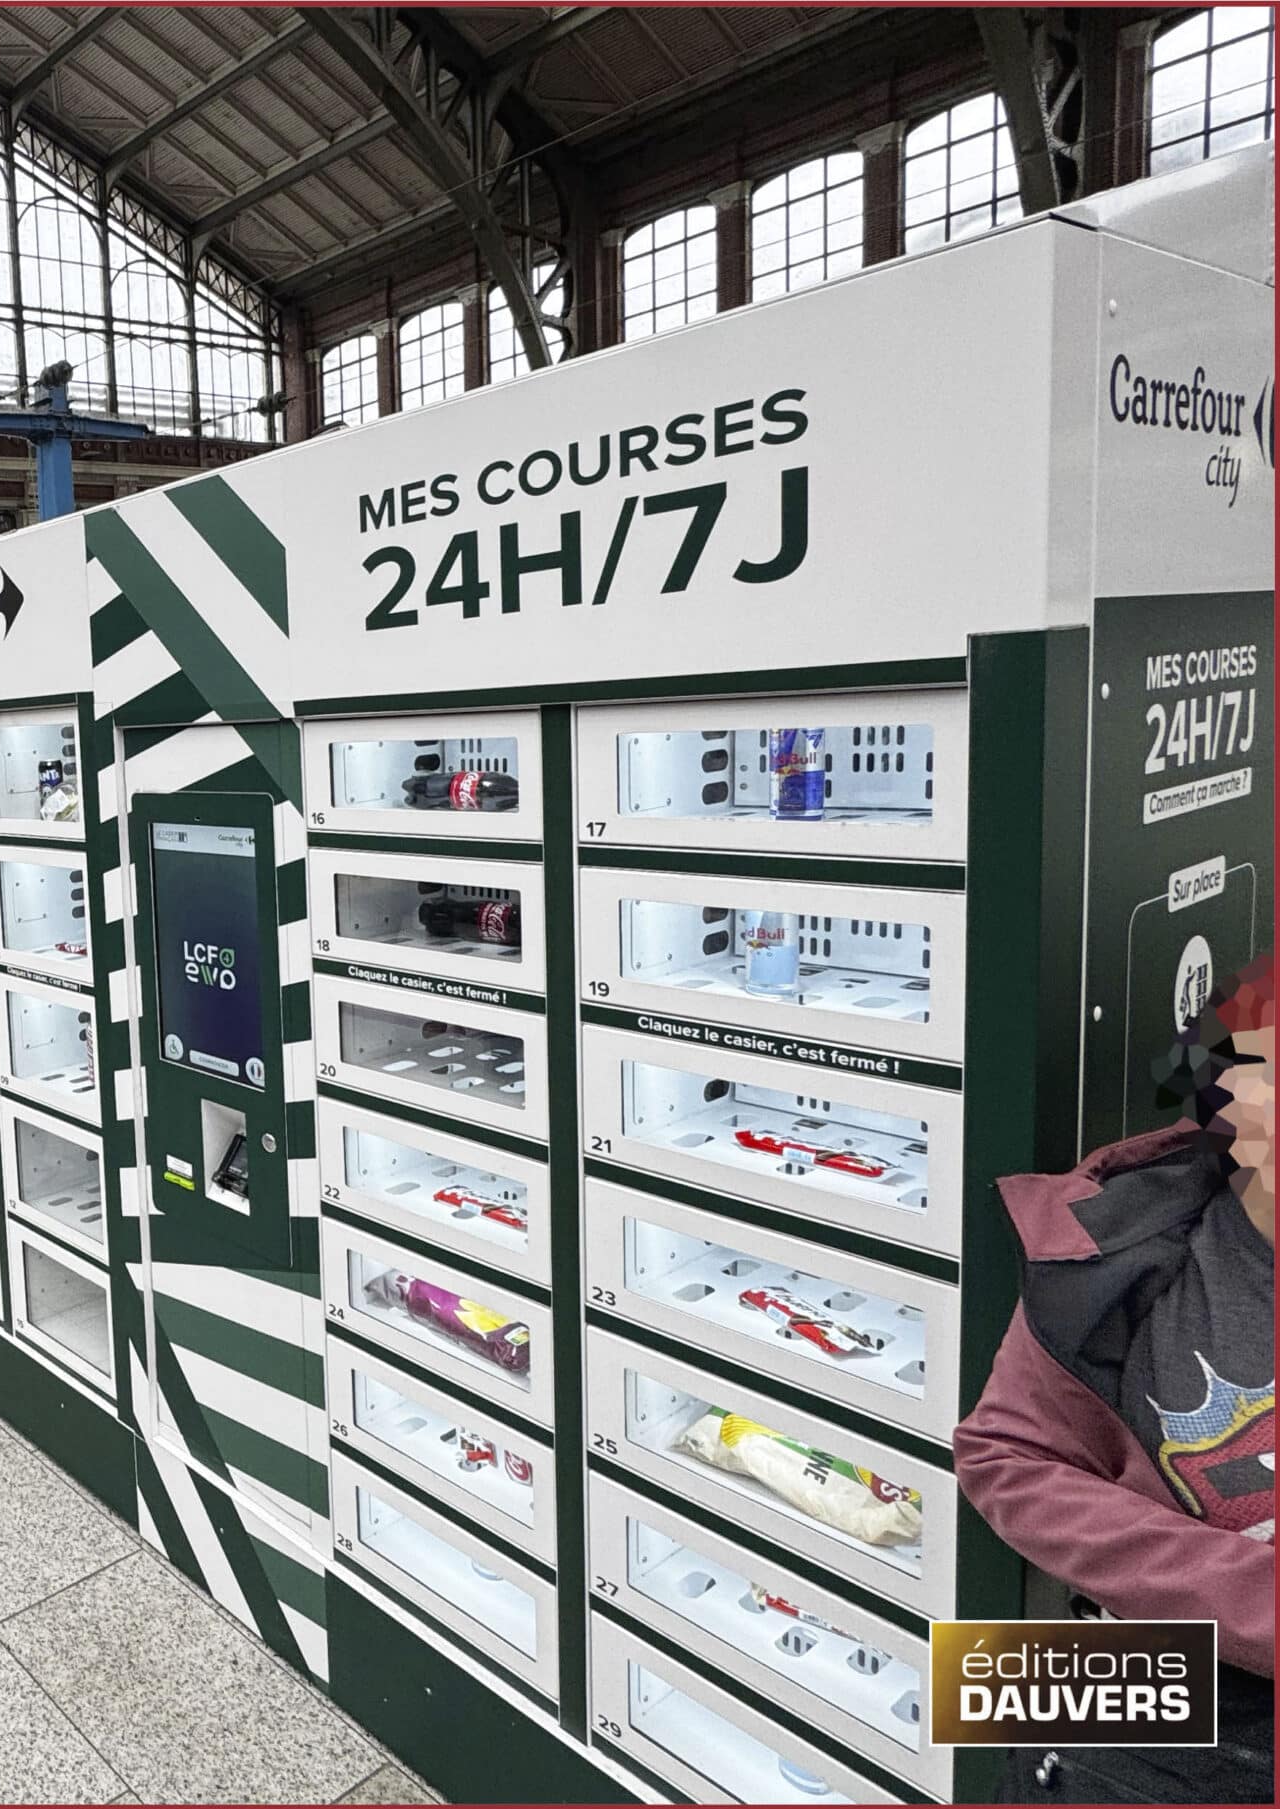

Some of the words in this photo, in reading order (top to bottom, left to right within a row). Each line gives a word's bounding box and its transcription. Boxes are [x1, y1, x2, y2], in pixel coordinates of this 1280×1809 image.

[1110, 354, 1245, 437] Carrefour
[359, 473, 460, 533] MES
[476, 388, 809, 505] COURSES
[1205, 444, 1242, 509] city
[361, 465, 809, 631] 24H/7J
[1146, 653, 1182, 690] MES
[1185, 645, 1257, 685] COURSES
[1145, 688, 1256, 774] 24H/7J
[1149, 784, 1196, 815] Comment
[1196, 784, 1208, 807] ça
[1209, 774, 1241, 798] marche
[1243, 769, 1248, 789] ?
[311, 812, 326, 825] 16
[586, 822, 607, 838] 17
[1173, 876, 1191, 903] Sur
[1192, 869, 1221, 901] place
[757, 927, 785, 940] Bull
[183, 940, 219, 965] LCF
[316, 939, 330, 952] 18
[347, 965, 388, 982] Claquez
[389, 972, 399, 984] le
[401, 977, 435, 992] casier,
[436, 982, 464, 996] c'est
[466, 986, 501, 1004] fermé
[502, 993, 507, 1004] !
[588, 981, 610, 998] 19
[637, 1015, 701, 1039] Claquez
[705, 1027, 720, 1042] le
[723, 1032, 778, 1055] casier,
[782, 1042, 826, 1062] c'est
[830, 1050, 889, 1073] fermé
[894, 1061, 900, 1074] !
[319, 1063, 336, 1077] 20
[591, 1135, 612, 1154] 21
[323, 1184, 341, 1200] 22
[592, 1286, 617, 1307] 23
[328, 1303, 345, 1320] 24
[332, 1418, 349, 1438] 26
[593, 1432, 619, 1456] 25
[336, 1532, 354, 1552] 28
[595, 1575, 620, 1598] 27
[598, 1713, 622, 1738] 29
